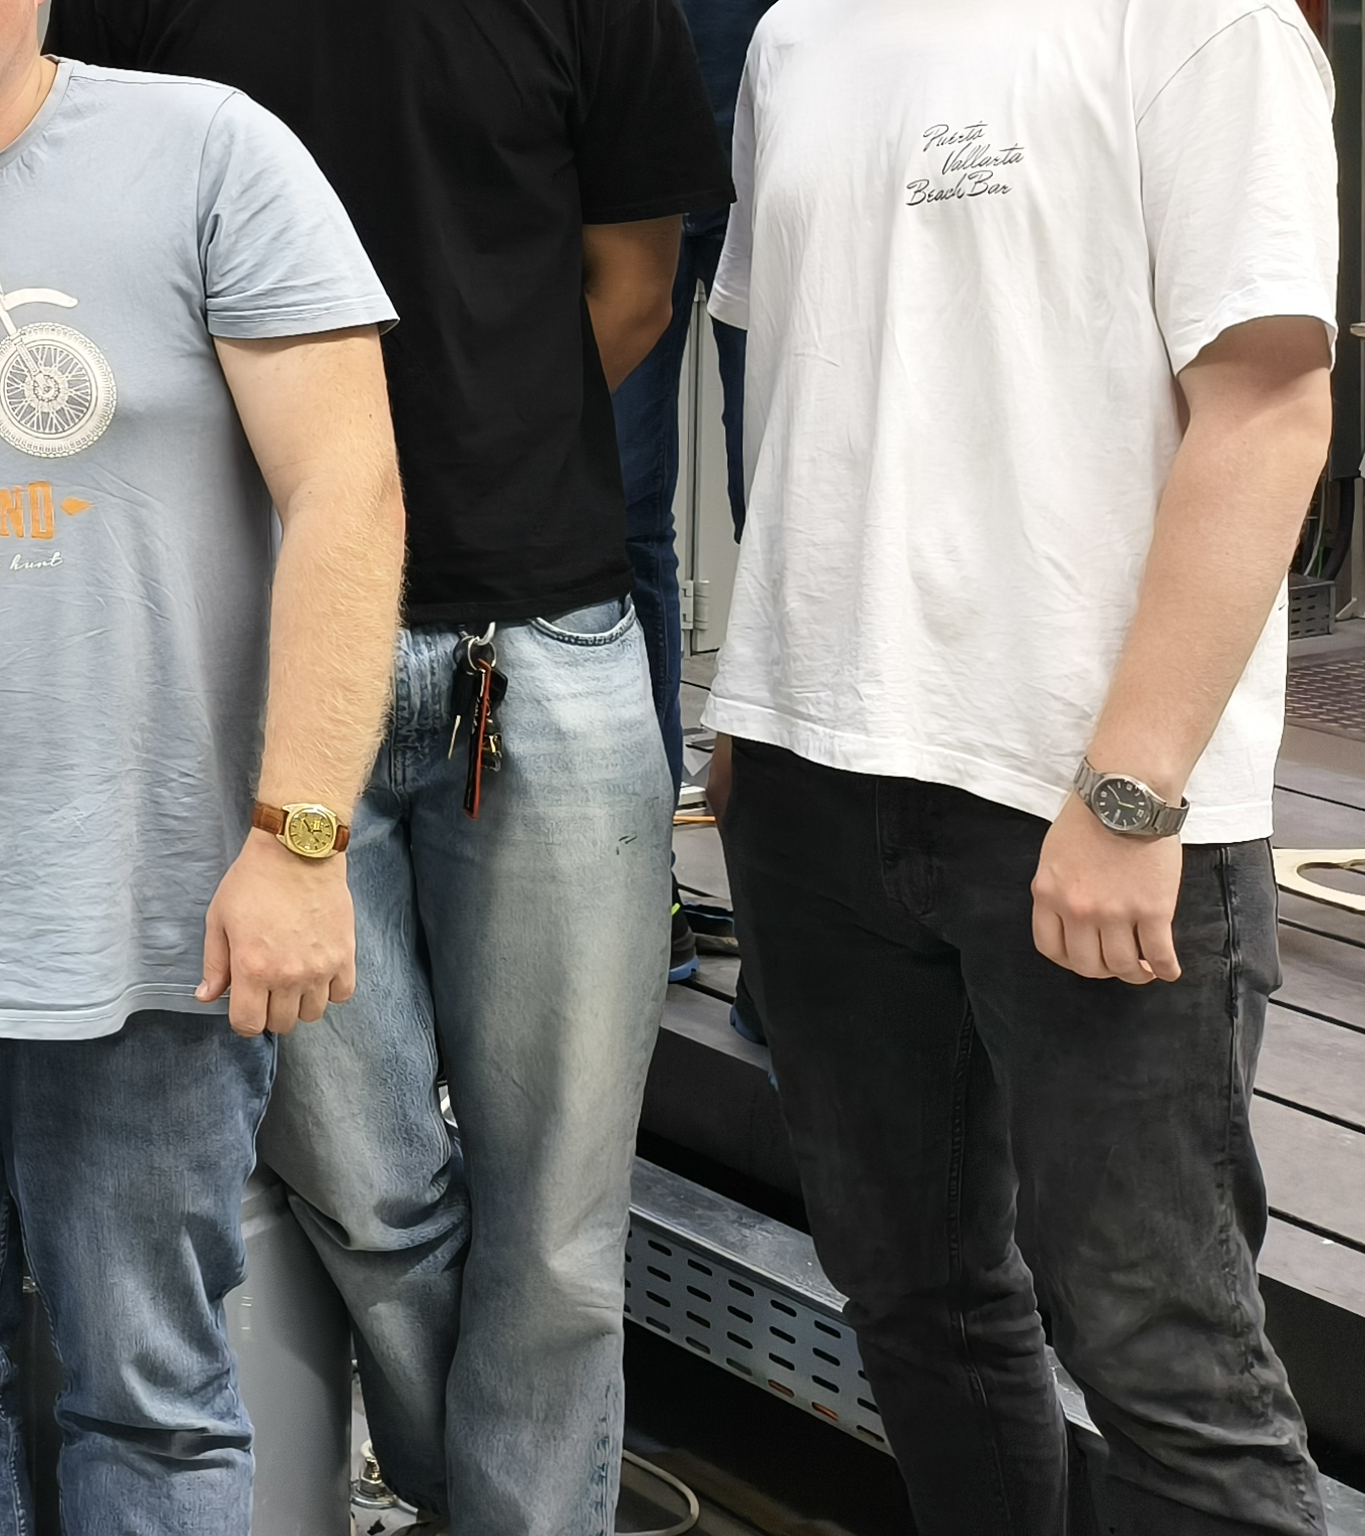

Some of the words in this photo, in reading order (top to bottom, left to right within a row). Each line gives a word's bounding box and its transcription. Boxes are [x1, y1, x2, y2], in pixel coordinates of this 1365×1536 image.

[941, 142, 1025, 175] Vallarta
[906, 173, 967, 206] Beach
[966, 169, 1012, 197] Bar
